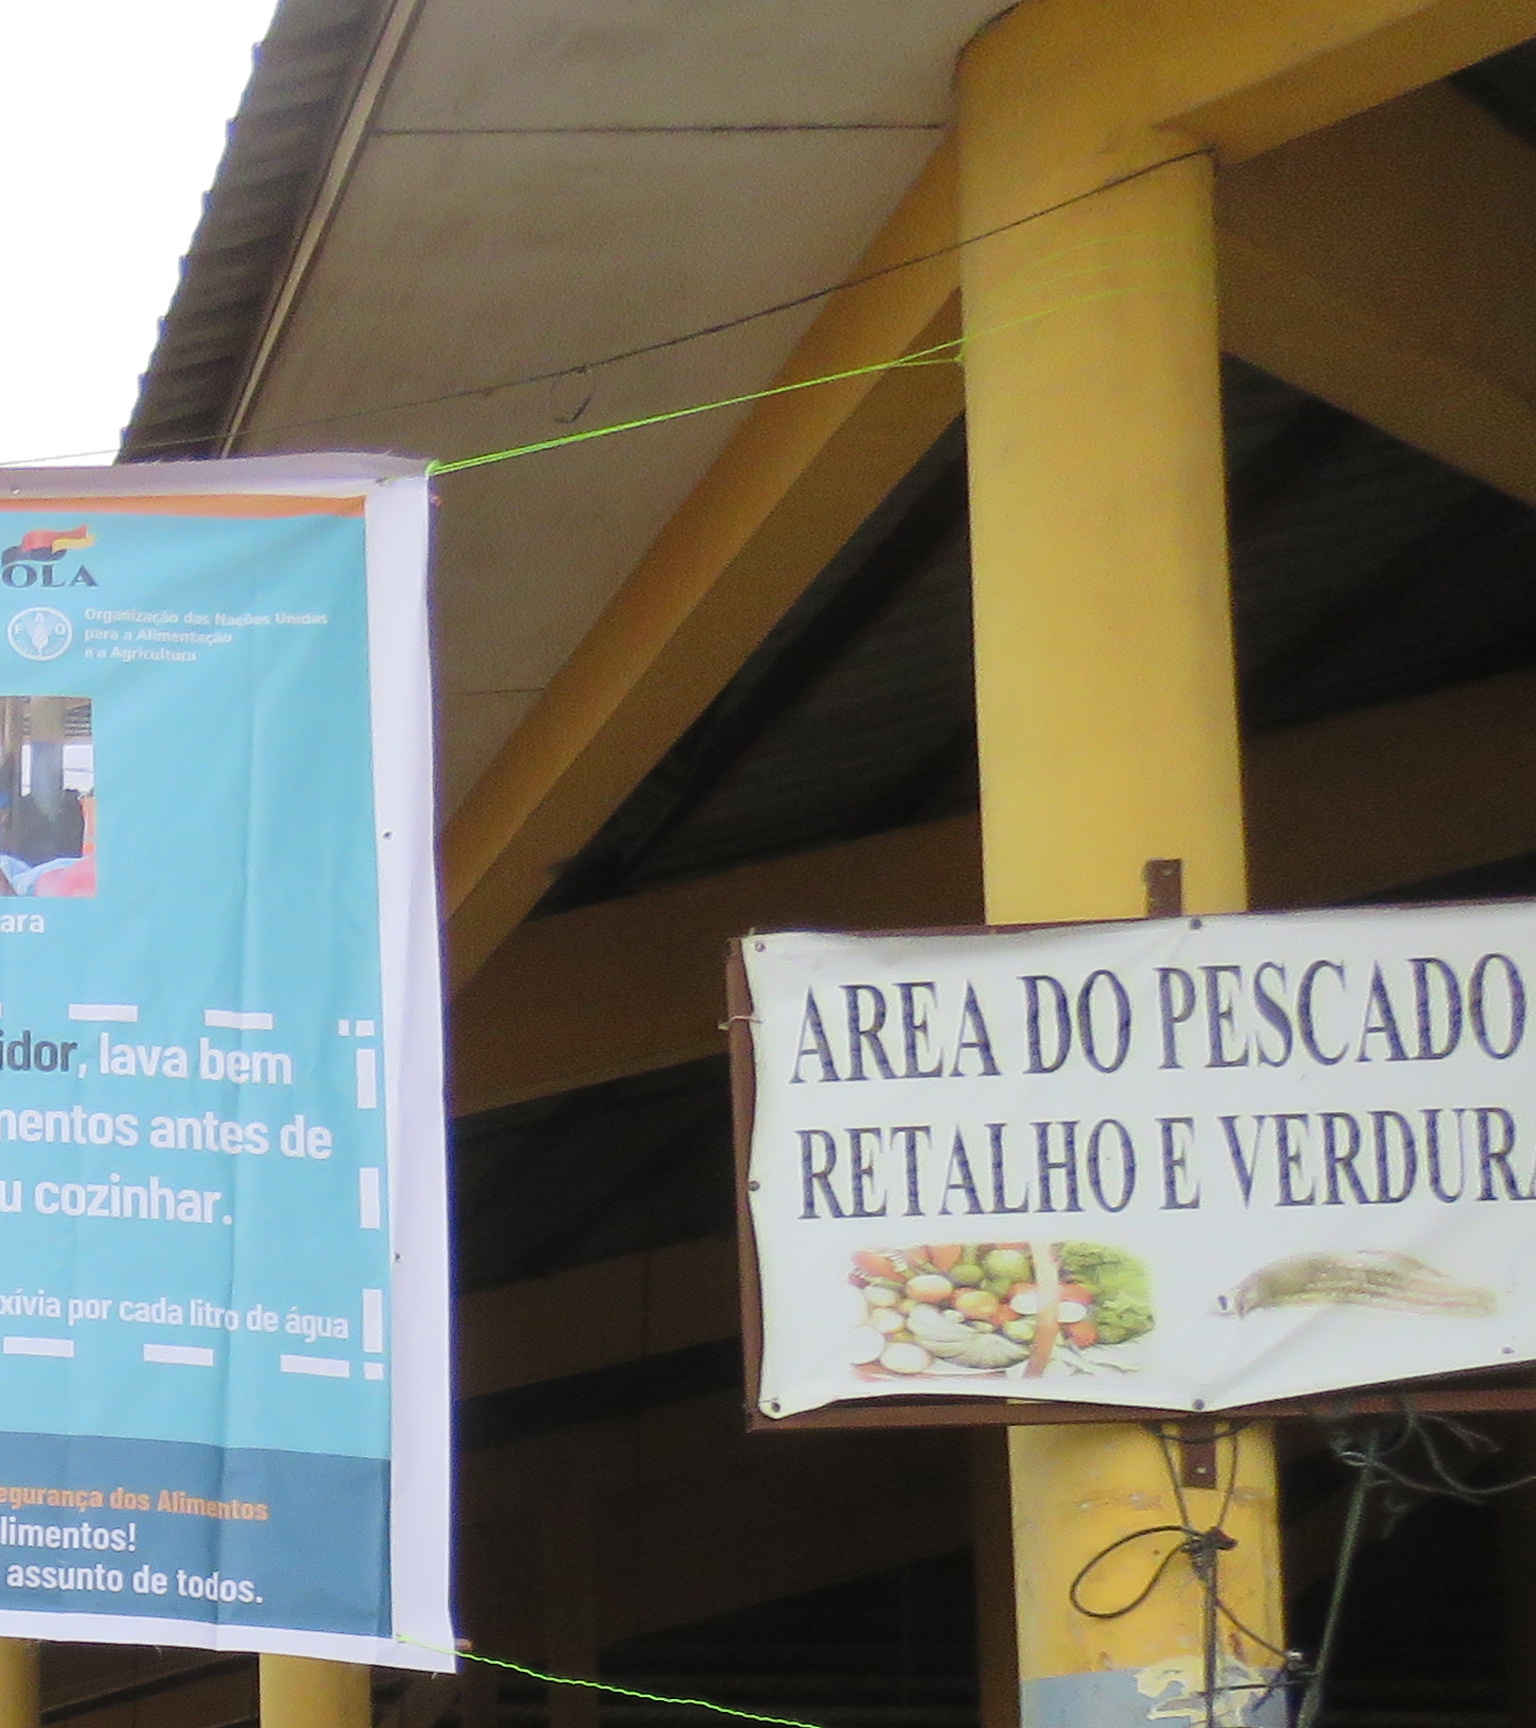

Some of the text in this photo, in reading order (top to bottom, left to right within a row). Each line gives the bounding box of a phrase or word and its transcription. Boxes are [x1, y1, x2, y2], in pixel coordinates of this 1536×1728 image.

[85, 607, 179, 625] Organização
[111, 647, 196, 663] Agricultura
[789, 953, 1526, 1085] AREA DO PESCADO
[98, 1032, 189, 1079] lava
[200, 1037, 294, 1084] bem
[149, 1111, 270, 1156] antes
[280, 1115, 334, 1160] de
[796, 1107, 1536, 1220] RETALHO E VERDUR
[35, 1173, 234, 1224] cozinhar.
[66, 1298, 114, 1325] por
[119, 1297, 185, 1325] cada
[189, 1299, 242, 1333] litro
[246, 1304, 284, 1332] de
[284, 1306, 351, 1343] água
[109, 1487, 150, 1511] dos
[157, 1489, 270, 1521] Alimentos
[7, 1564, 123, 1592] assunto
[133, 1565, 167, 1594] de
[177, 1570, 263, 1603] todos.
